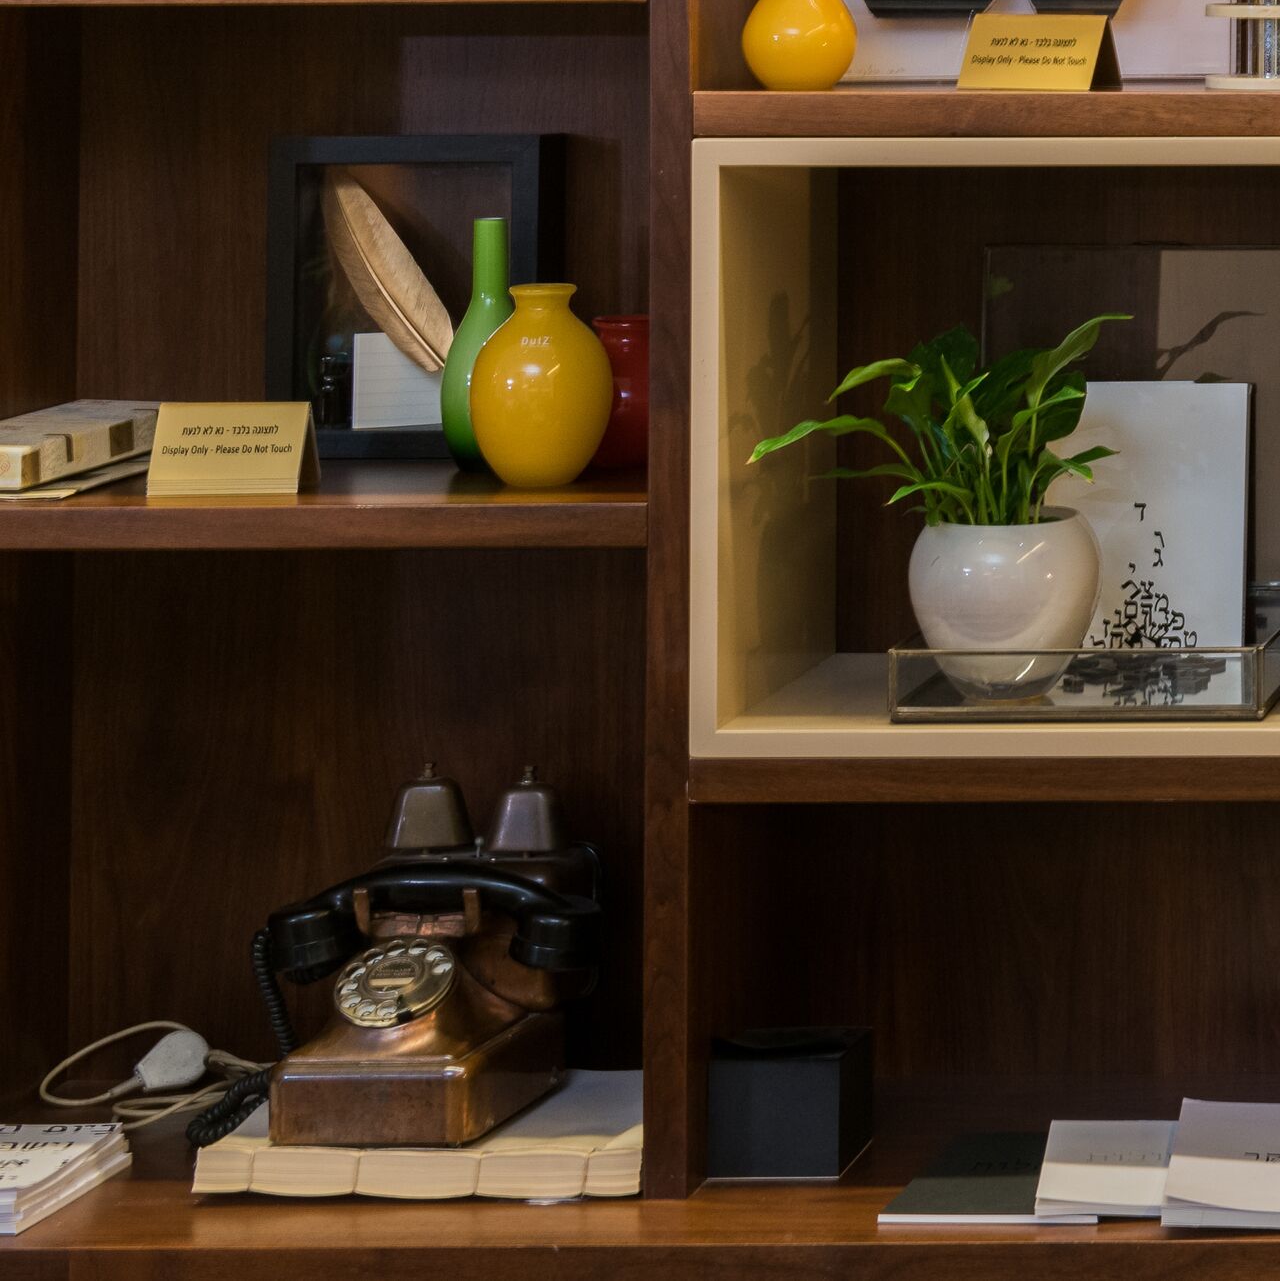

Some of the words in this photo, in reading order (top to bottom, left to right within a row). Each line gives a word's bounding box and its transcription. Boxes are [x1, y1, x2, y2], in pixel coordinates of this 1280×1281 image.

[971, 54, 996, 66] Display
[997, 54, 1013, 66] Only
[1018, 55, 1039, 64] Please
[1042, 56, 1052, 64] Do
[1053, 56, 1065, 64] Not
[1067, 56, 1087, 65] Touch
[161, 445, 189, 457] Display
[190, 445, 209, 456] Only
[215, 444, 240, 454] Please
[241, 444, 253, 454] Do
[254, 444, 269, 453] Not
[270, 443, 293, 454] Touch
